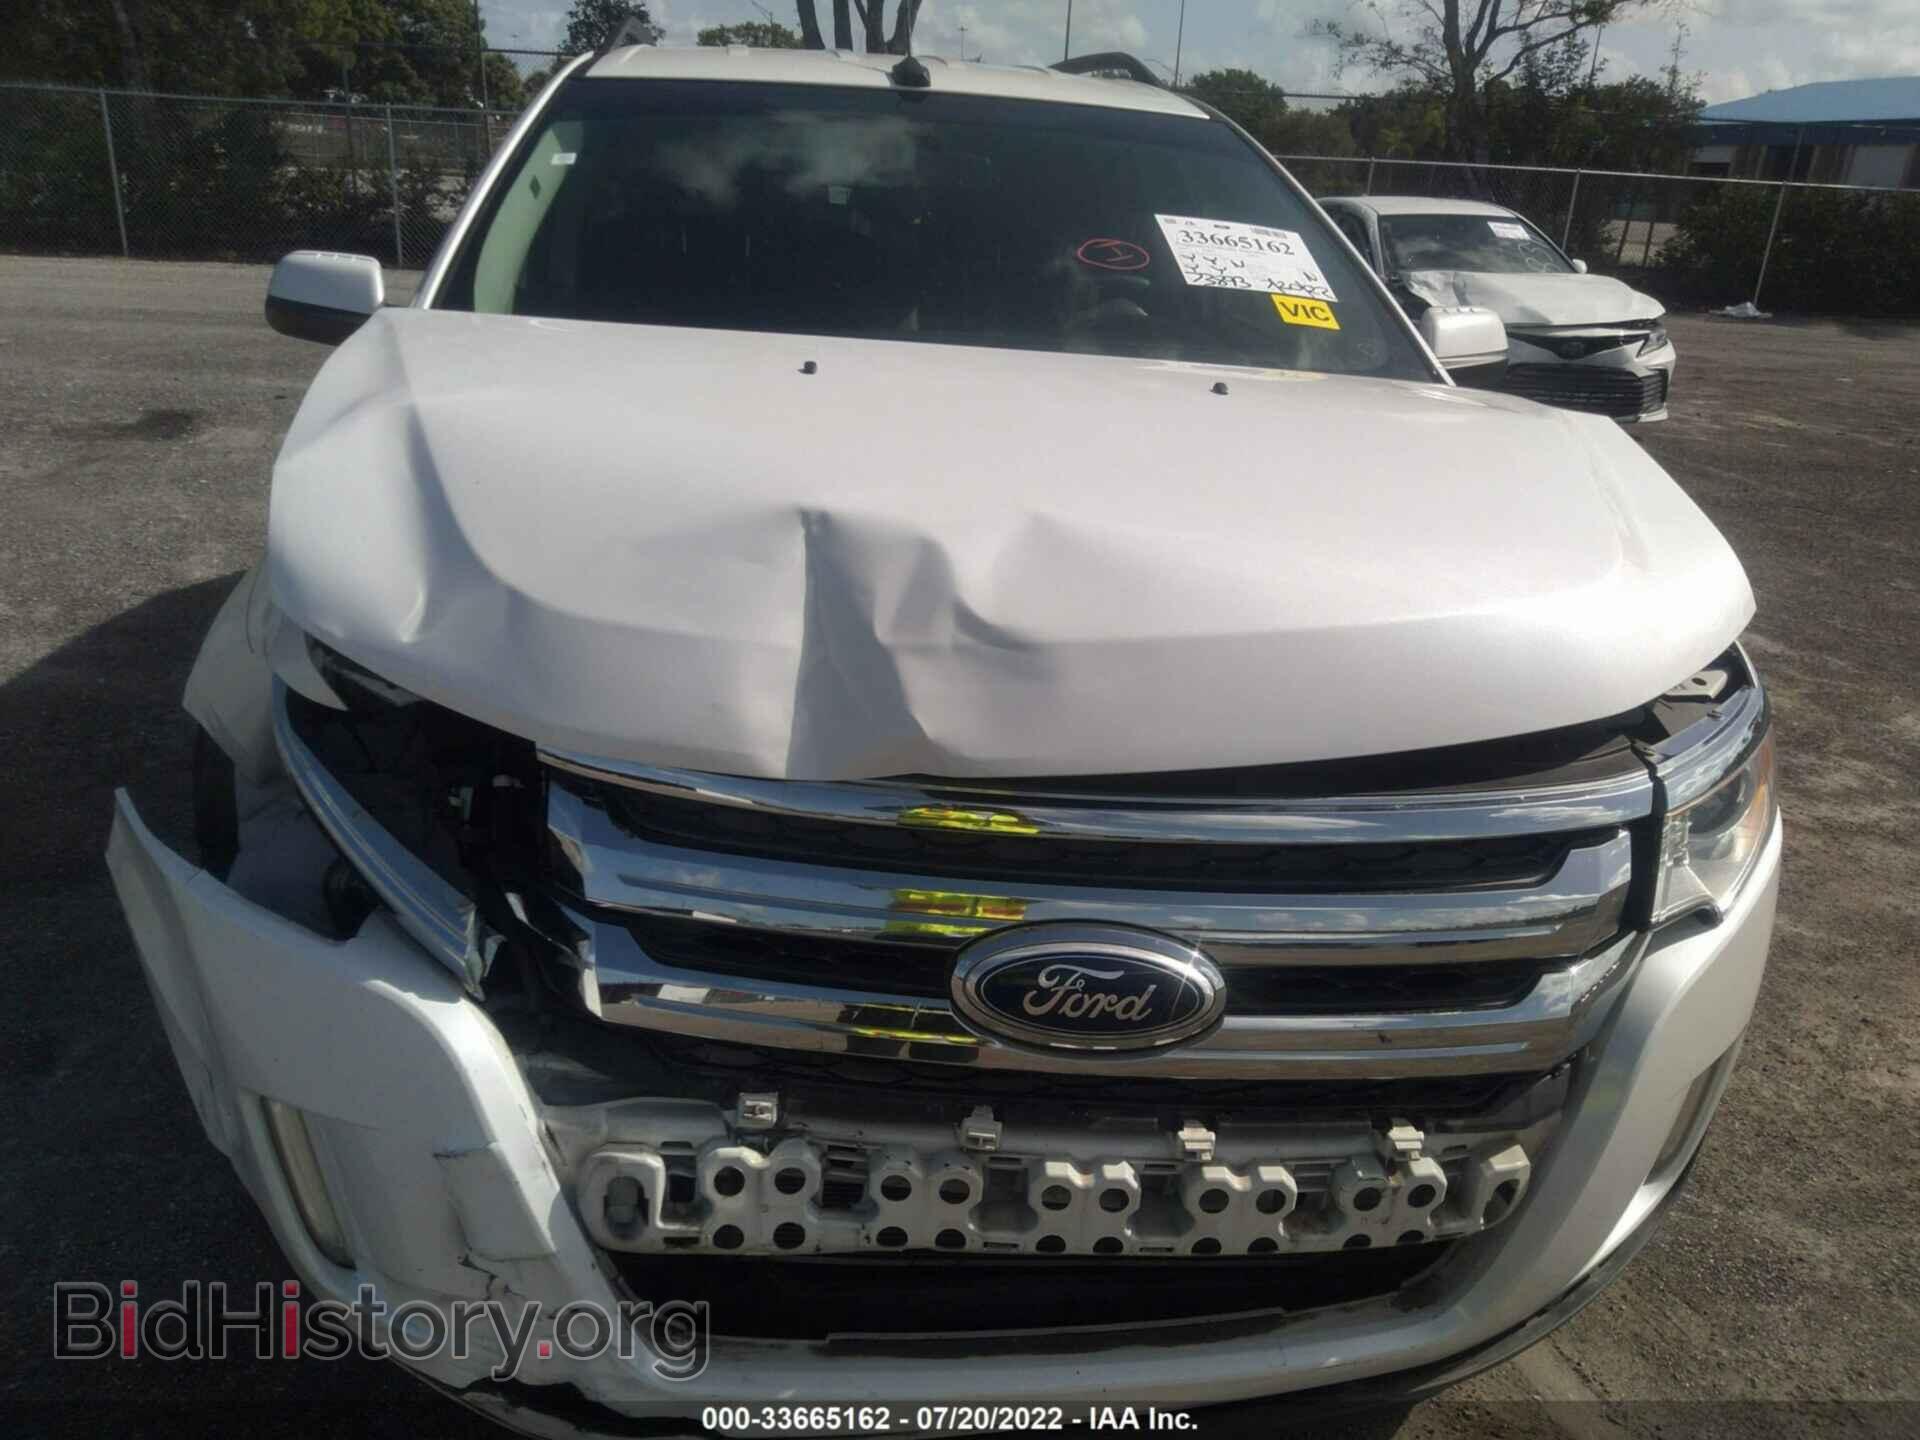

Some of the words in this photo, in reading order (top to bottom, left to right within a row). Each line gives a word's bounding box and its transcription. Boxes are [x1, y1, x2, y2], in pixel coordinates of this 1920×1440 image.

[1177, 229, 1295, 255] 33665162
[1278, 300, 1330, 322] VIC
[1022, 963, 1158, 1021] Ford
